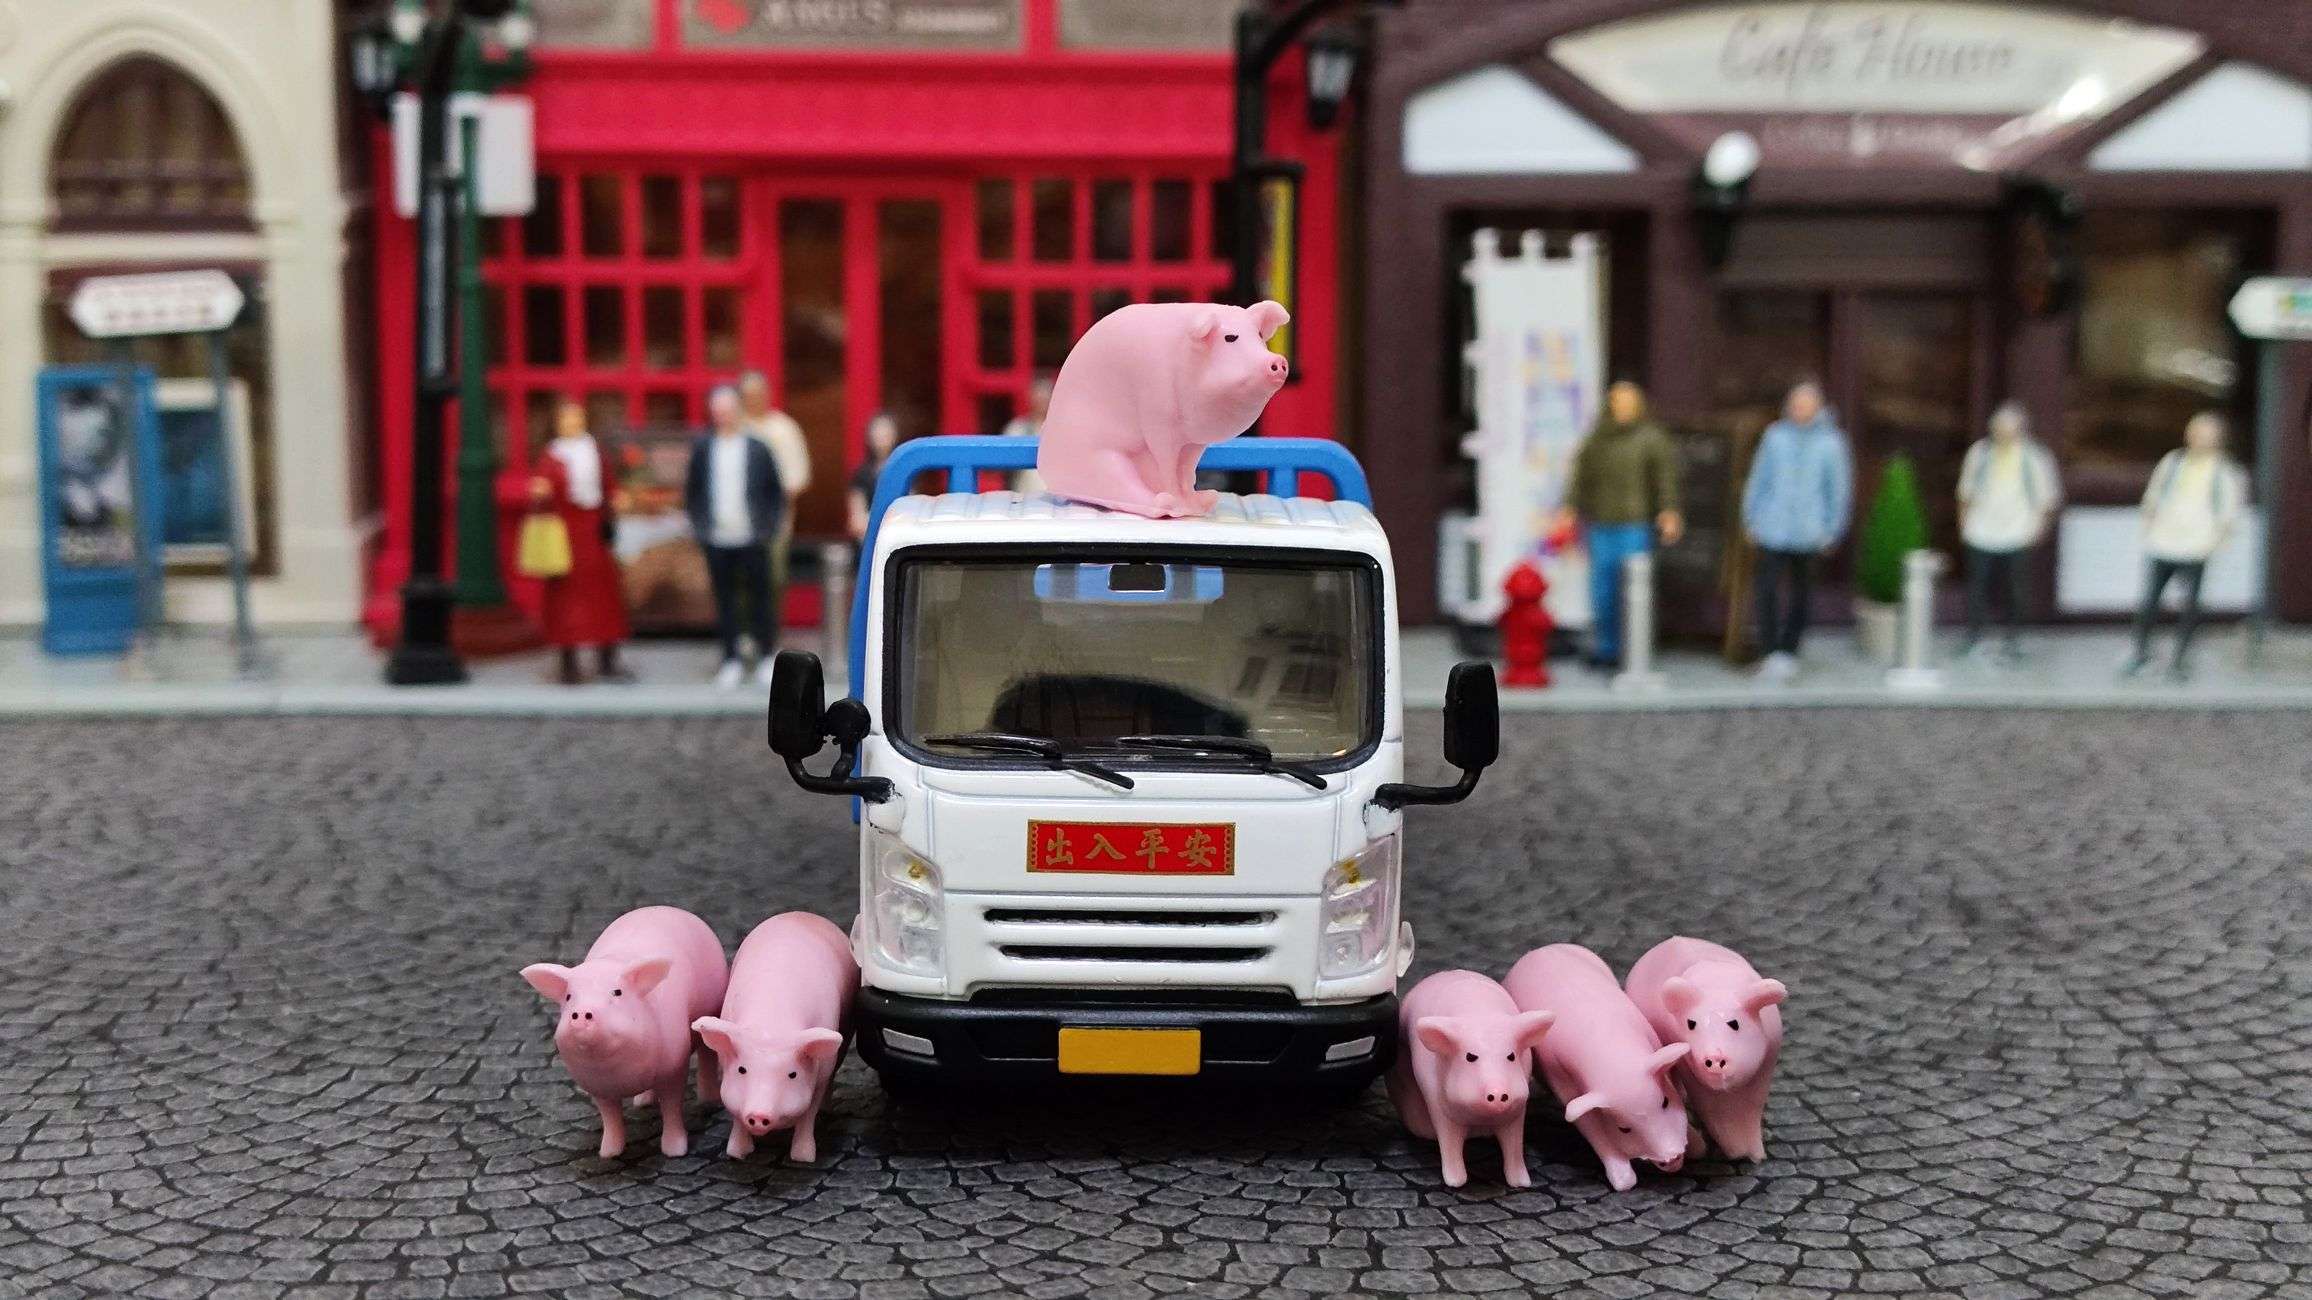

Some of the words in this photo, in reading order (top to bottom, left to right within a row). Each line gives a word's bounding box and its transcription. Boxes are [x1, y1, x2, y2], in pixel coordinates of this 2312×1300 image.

[1854, 11, 2016, 82] House
[1045, 827, 1217, 870] 出入平安
